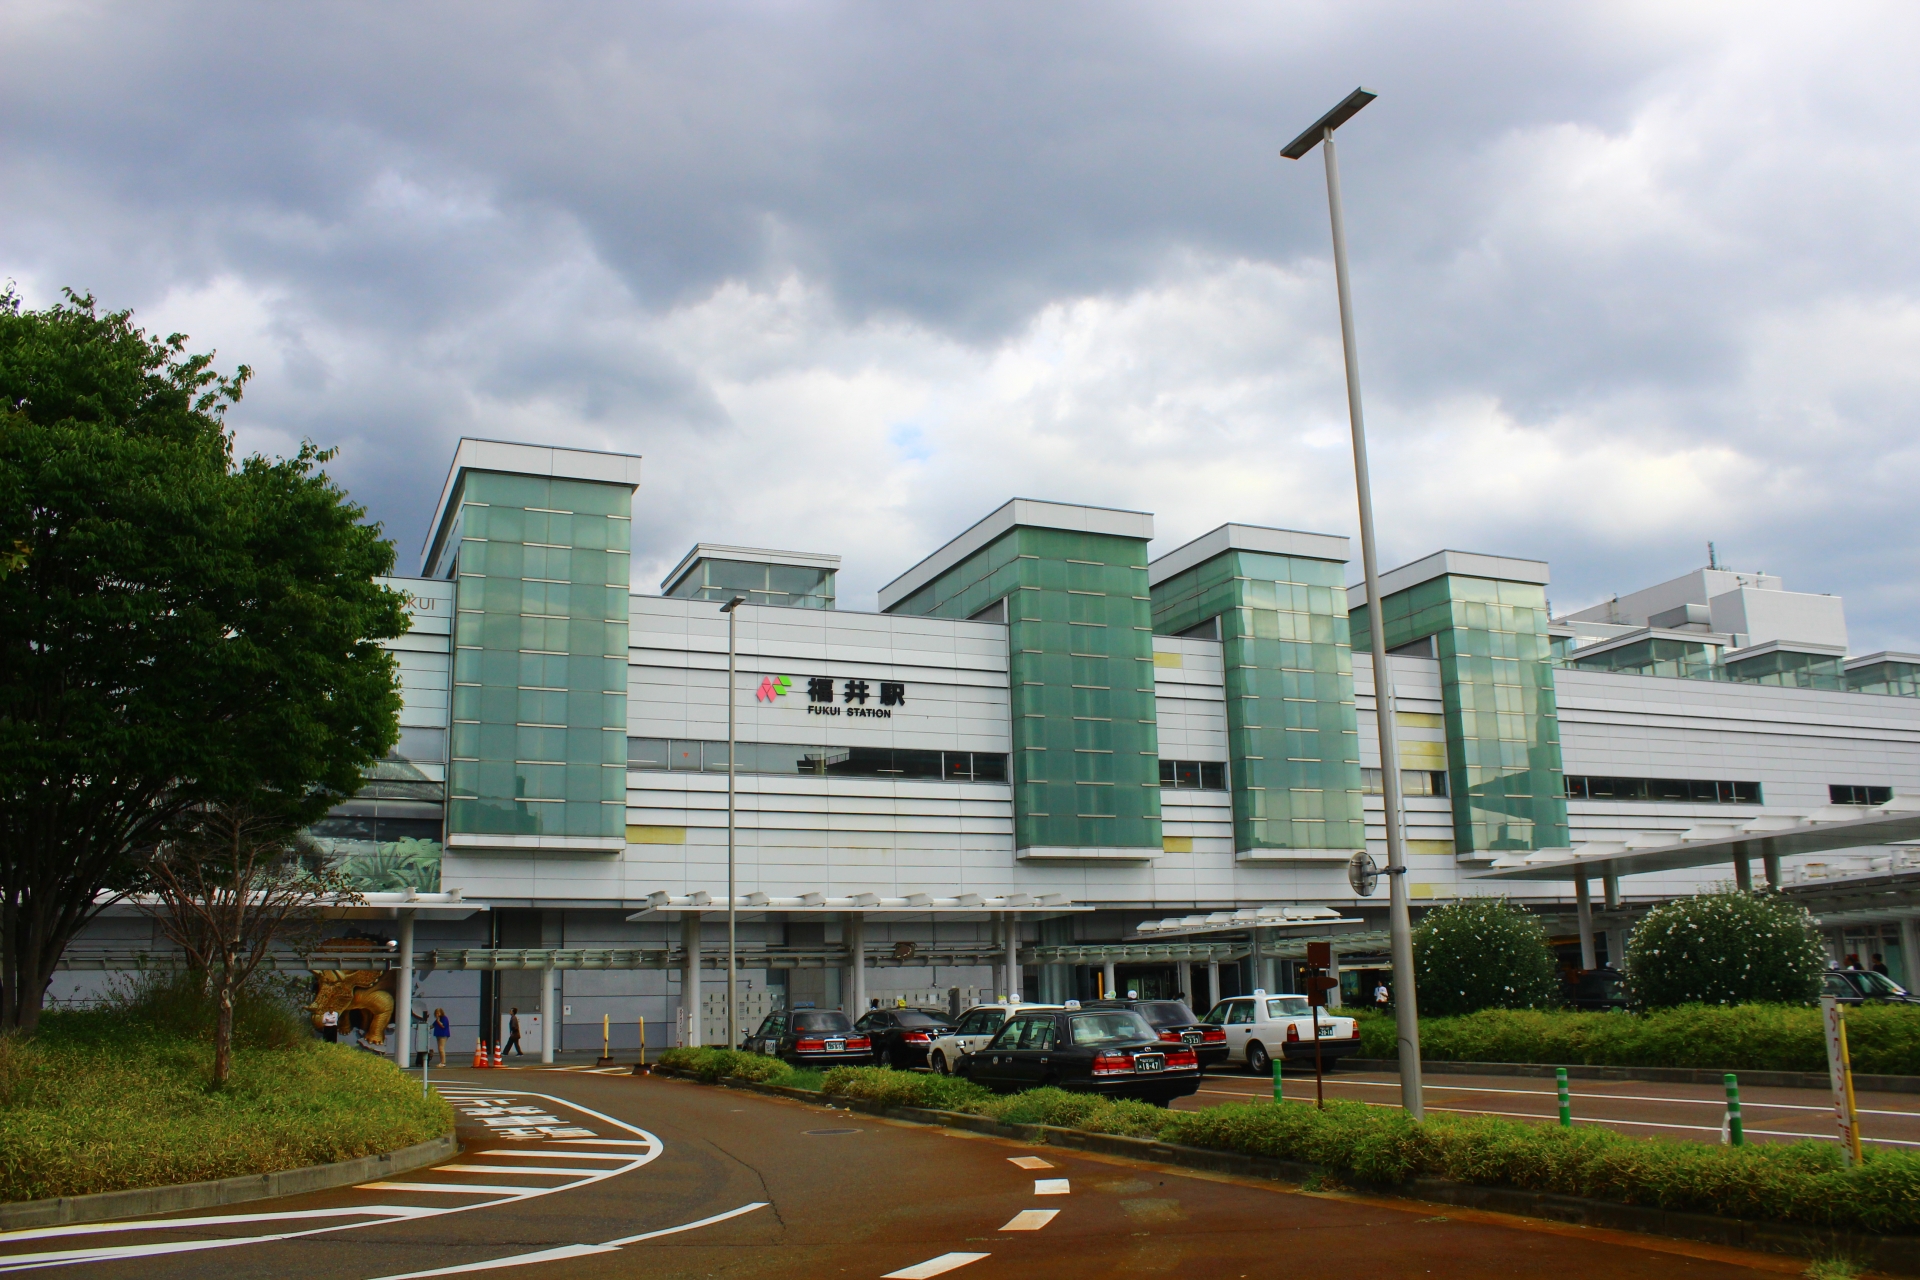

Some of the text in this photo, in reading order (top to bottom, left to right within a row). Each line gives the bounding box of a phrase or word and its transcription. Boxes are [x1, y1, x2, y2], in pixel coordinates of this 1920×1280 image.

[401, 597, 435, 610] KUI
[808, 678, 904, 706] 福井駅
[808, 705, 891, 718] FUKUI STATION
